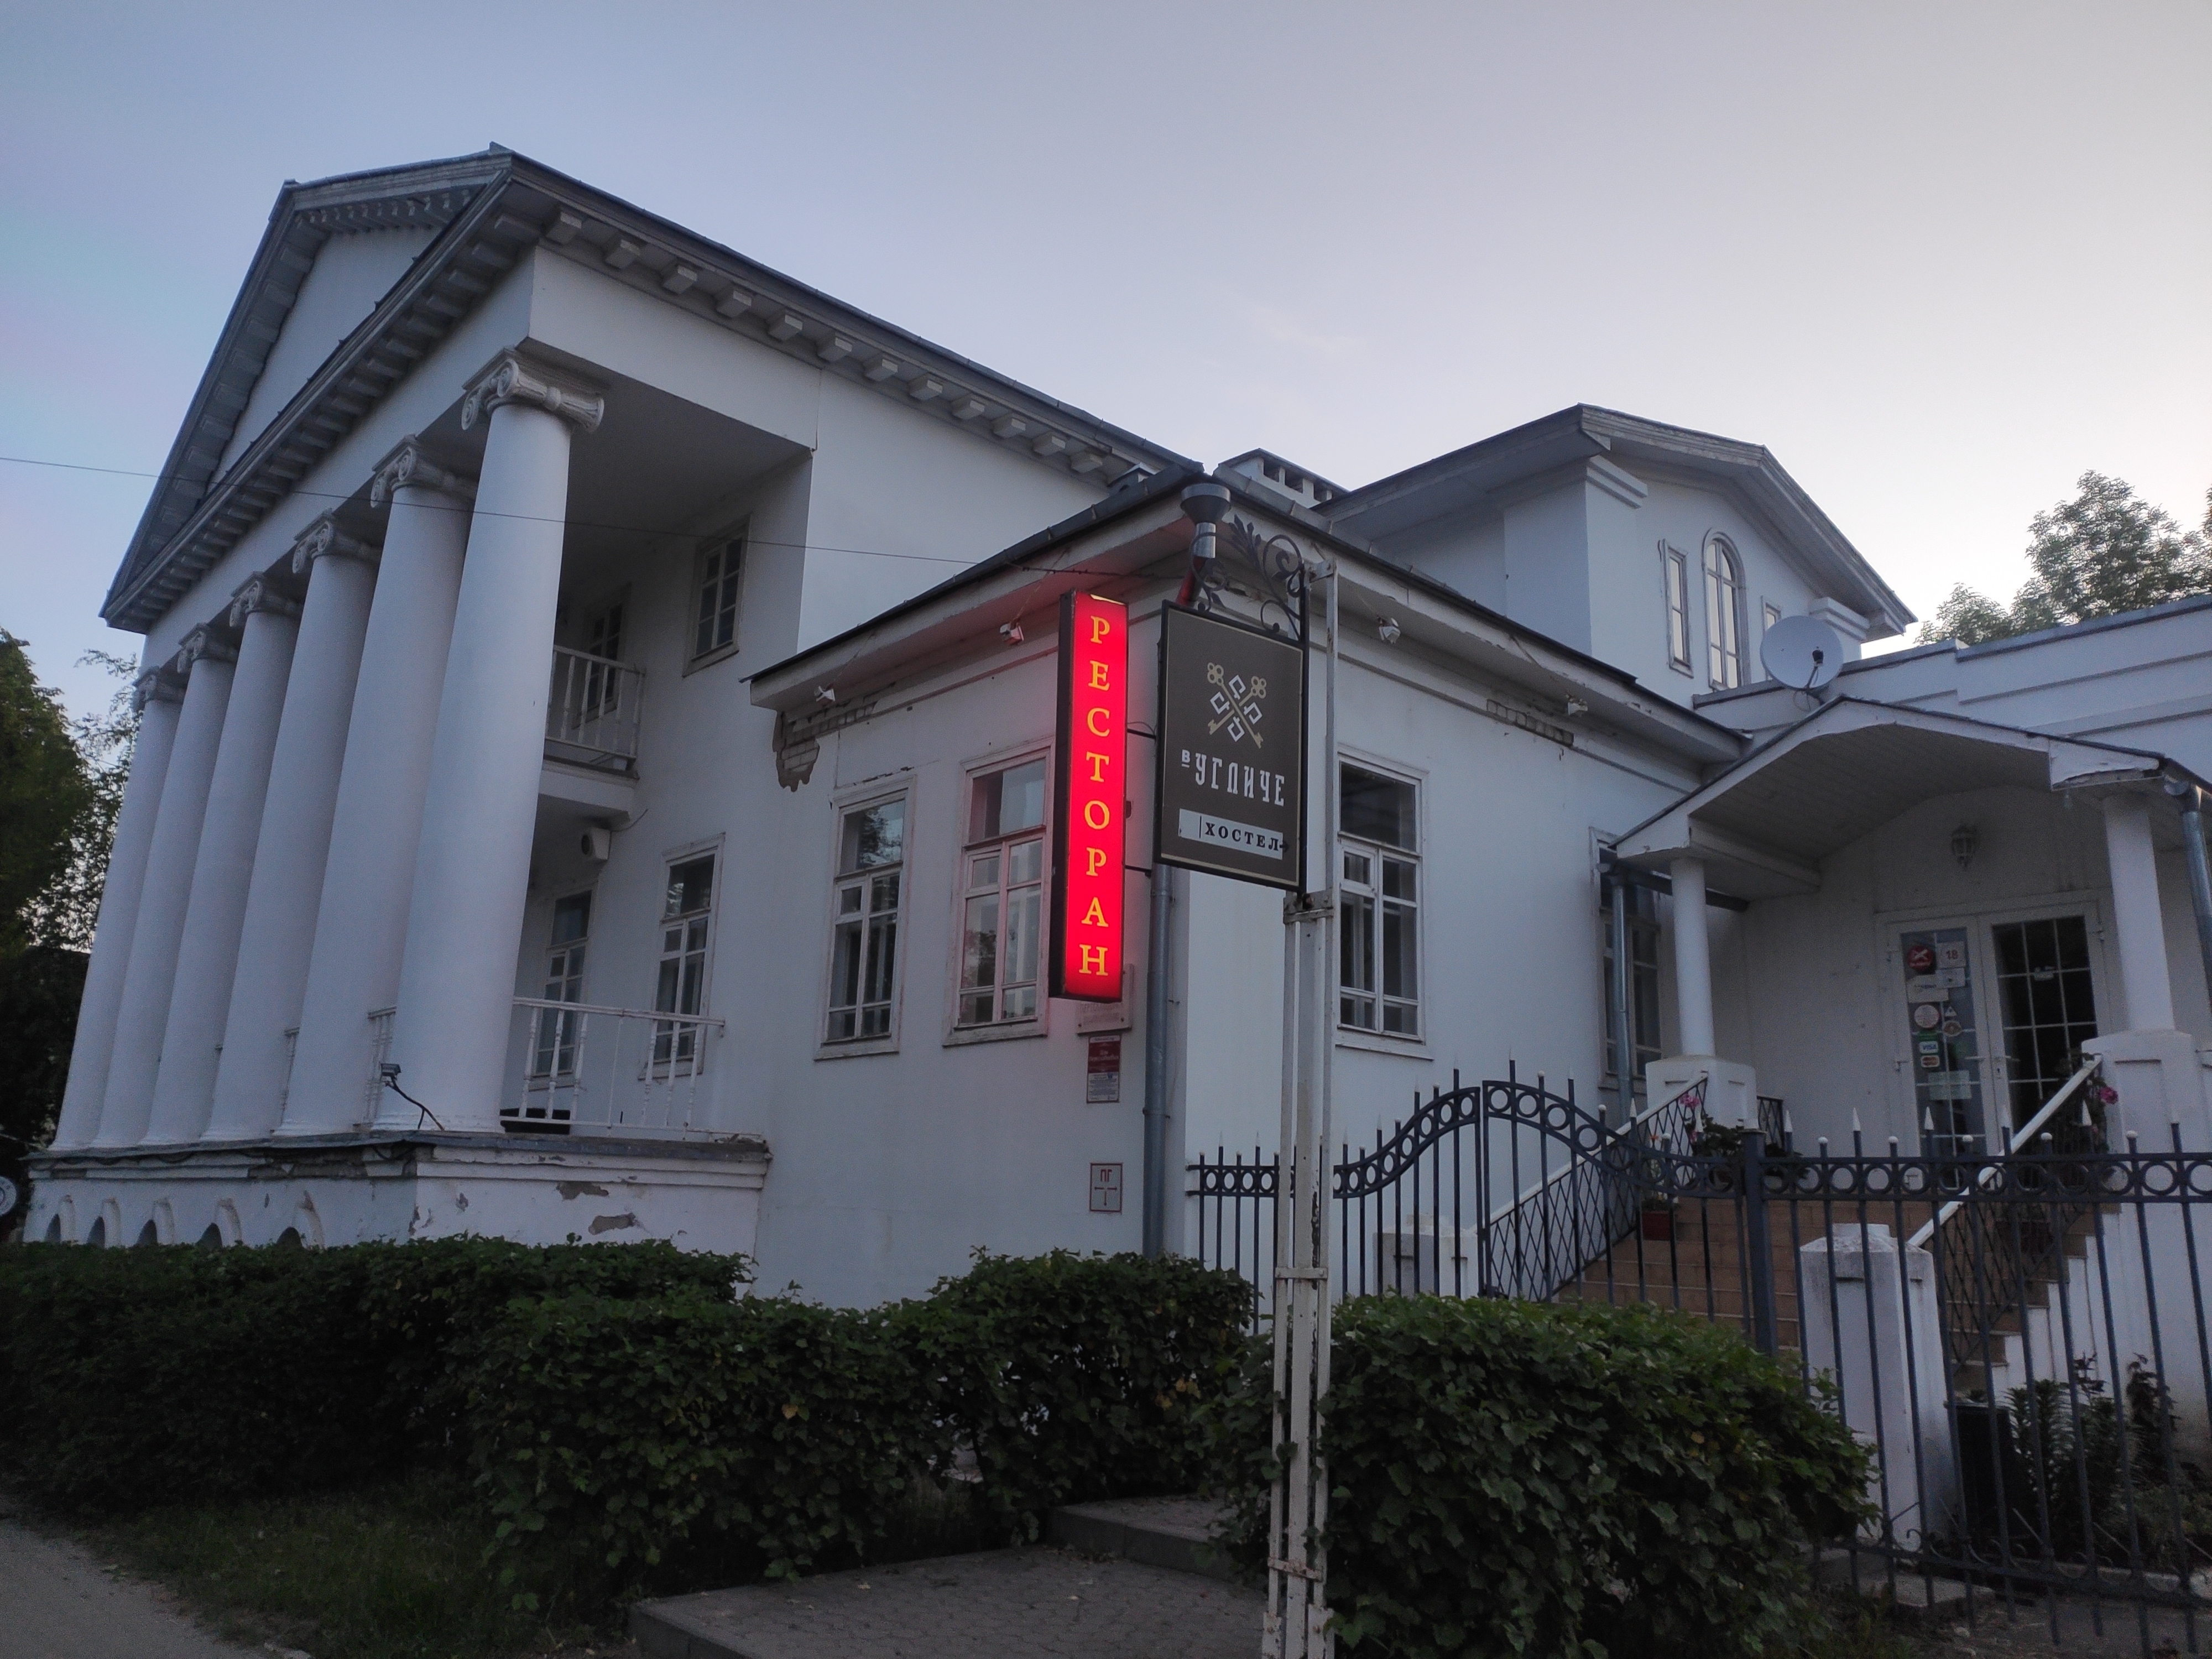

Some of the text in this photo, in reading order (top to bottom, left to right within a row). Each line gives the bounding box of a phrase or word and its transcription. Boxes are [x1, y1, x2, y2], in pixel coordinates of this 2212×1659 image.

[1078, 615, 1110, 977] РЕСТОРАН
[1195, 752, 1285, 807] УГЛИЧЕ
[1204, 822, 1279, 852] ХОСТЕЛ
[1100, 1168, 1113, 1182] ПГ
